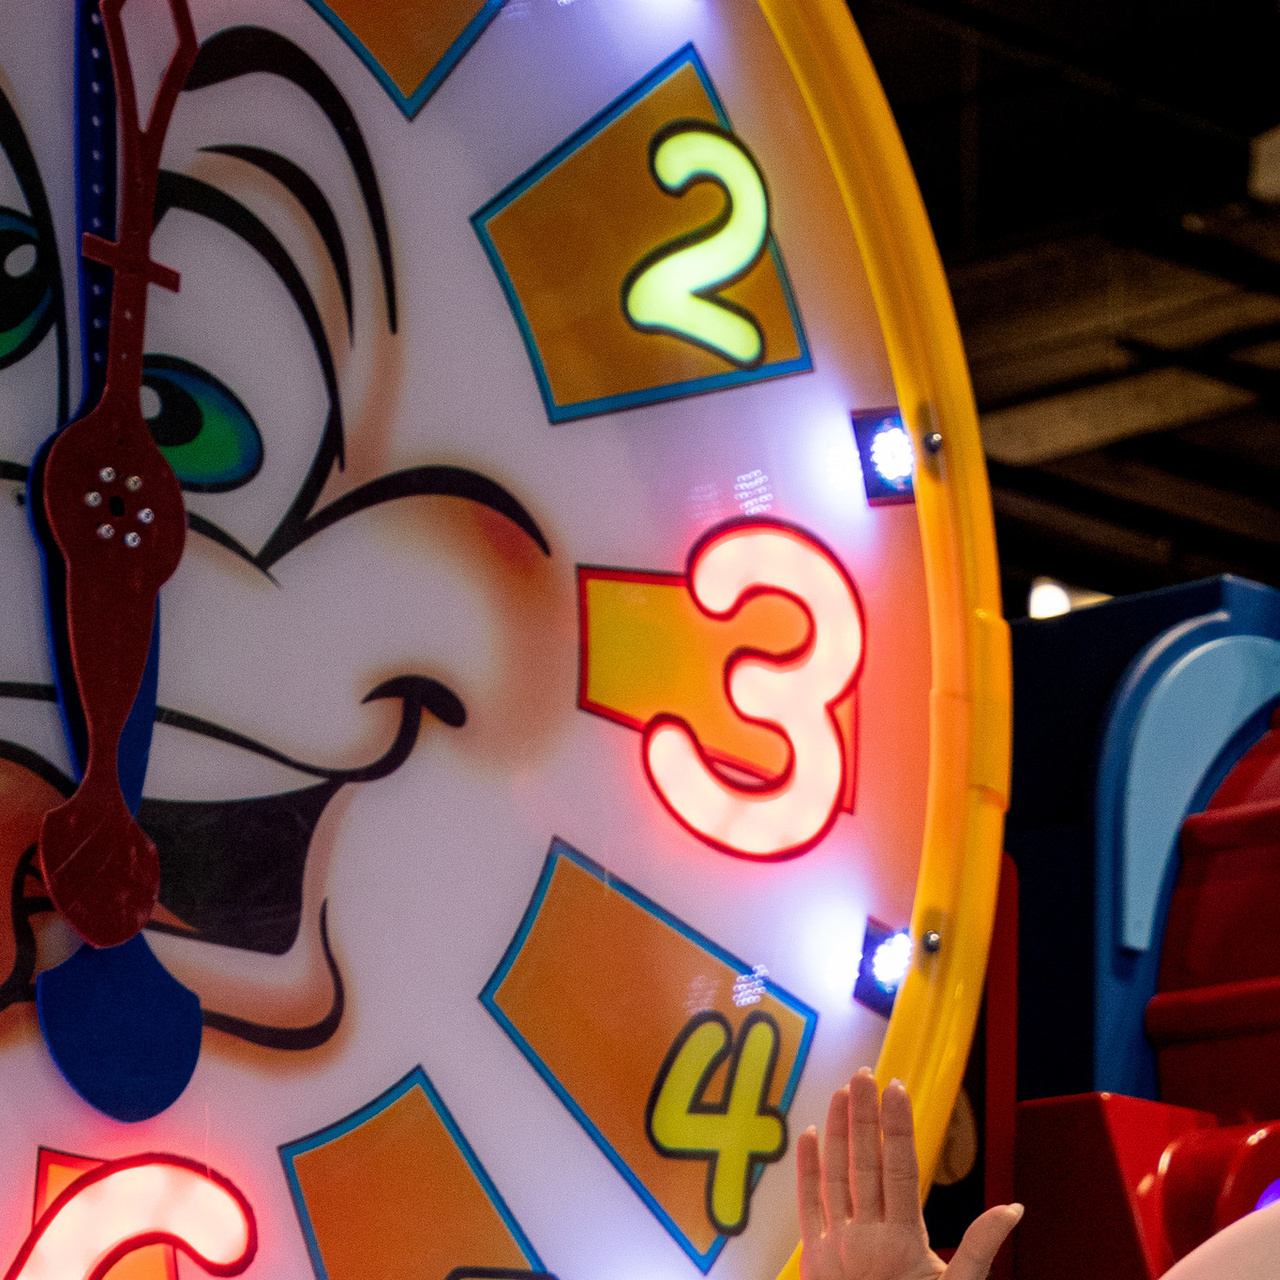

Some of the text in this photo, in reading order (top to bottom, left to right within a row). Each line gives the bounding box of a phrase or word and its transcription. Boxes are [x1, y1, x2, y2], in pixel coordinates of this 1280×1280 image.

[624, 120, 769, 367] 2
[643, 515, 866, 862] 3
[647, 1010, 787, 1235] 4
